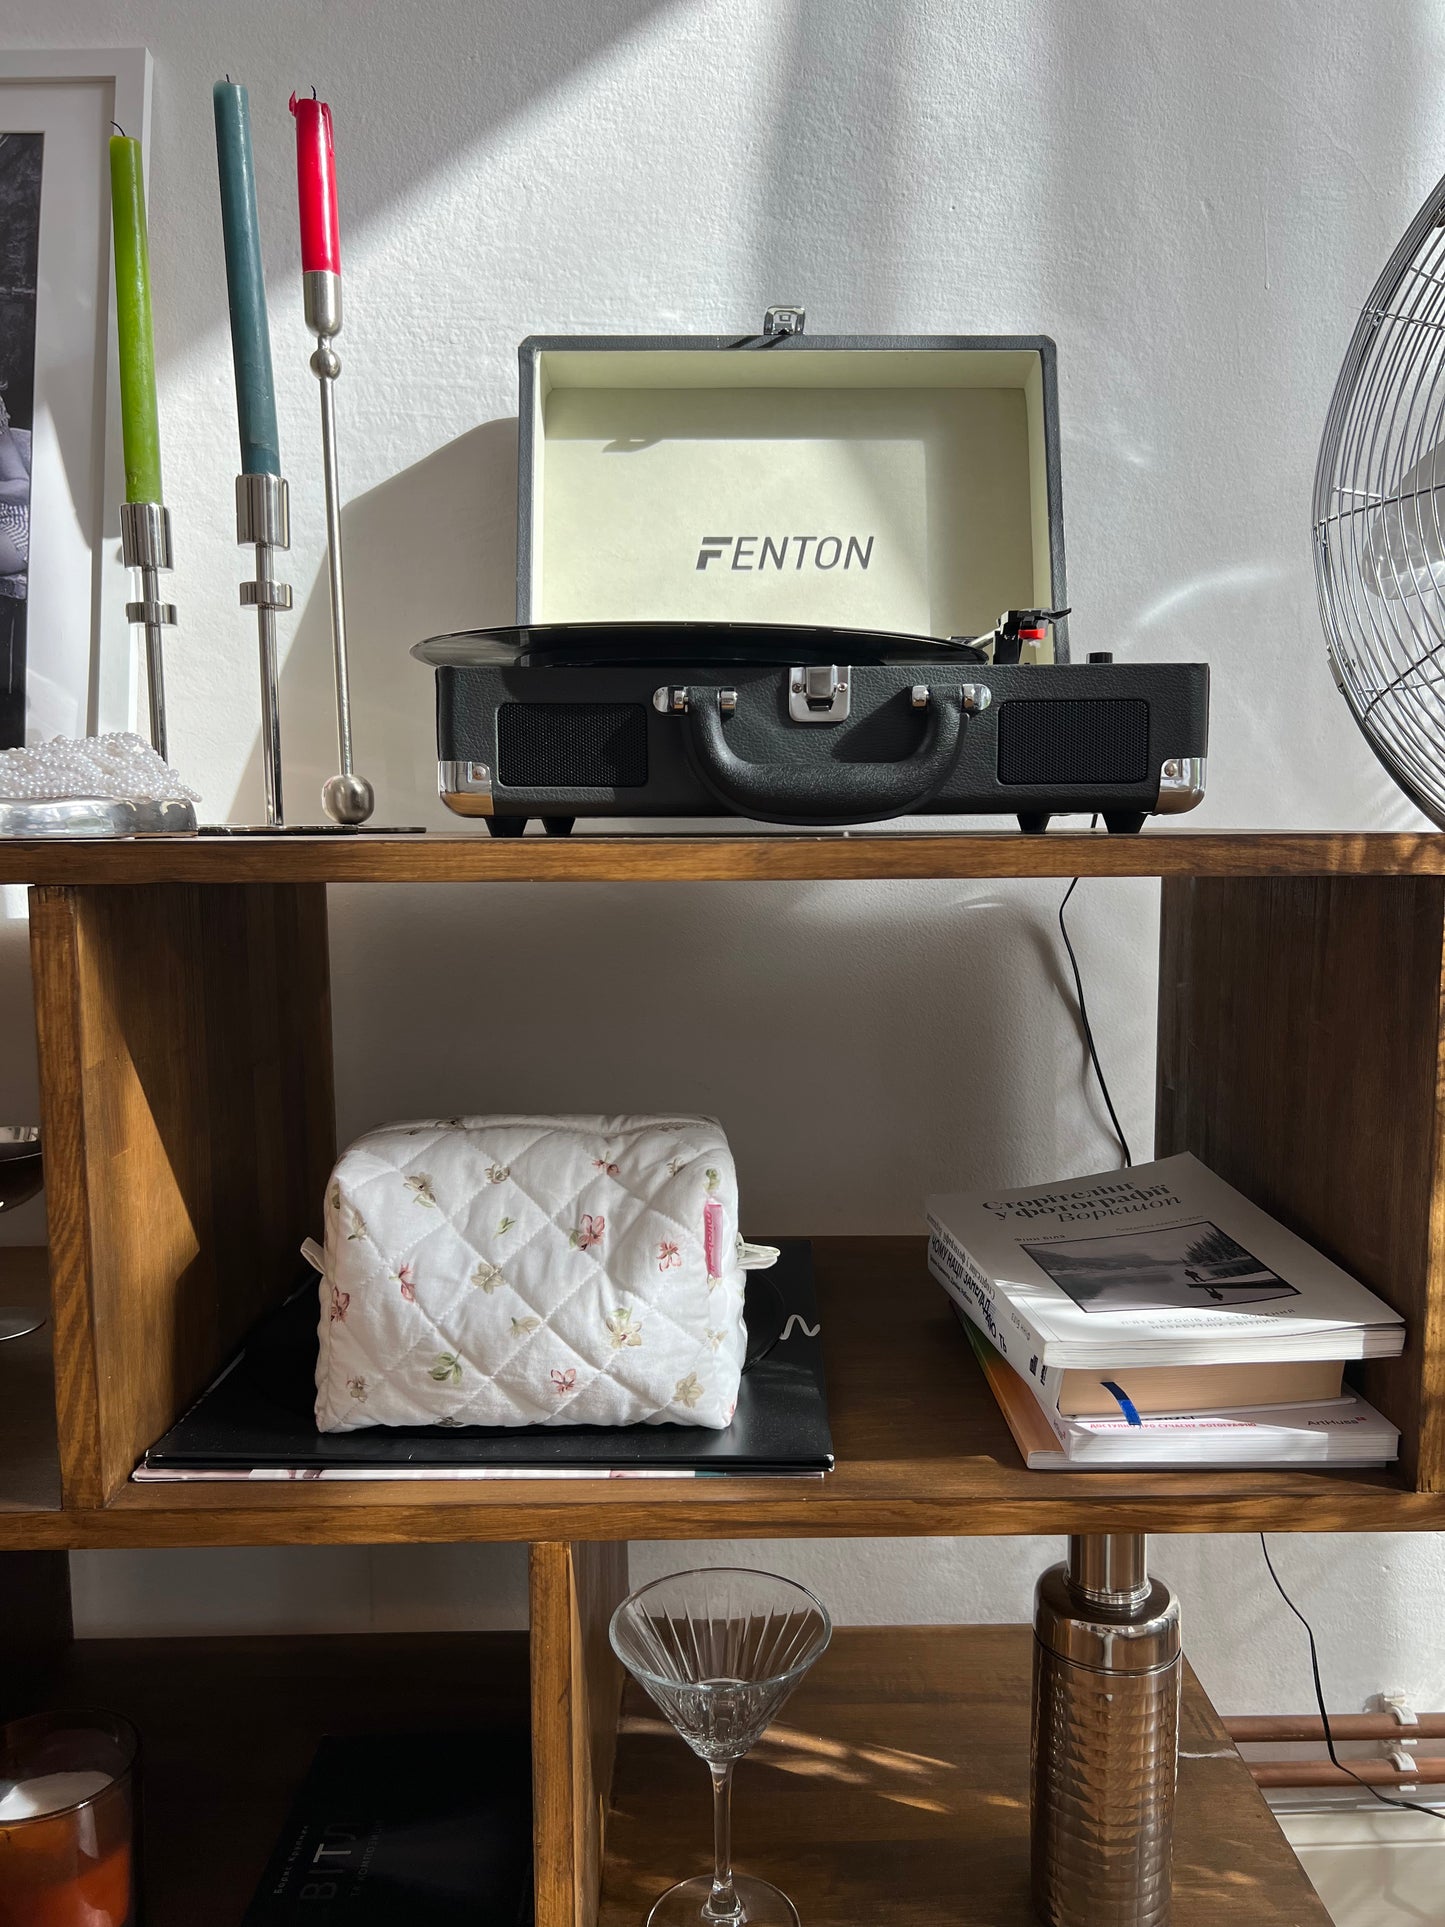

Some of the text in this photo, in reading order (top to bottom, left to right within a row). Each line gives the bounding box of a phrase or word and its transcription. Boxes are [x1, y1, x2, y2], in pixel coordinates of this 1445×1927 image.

[695, 536, 875, 570] FENTON
[982, 1182, 1134, 1210] Сторітелінг
[993, 1184, 1172, 1221] у фотографії
[1057, 1195, 1182, 1223] Воркшоп
